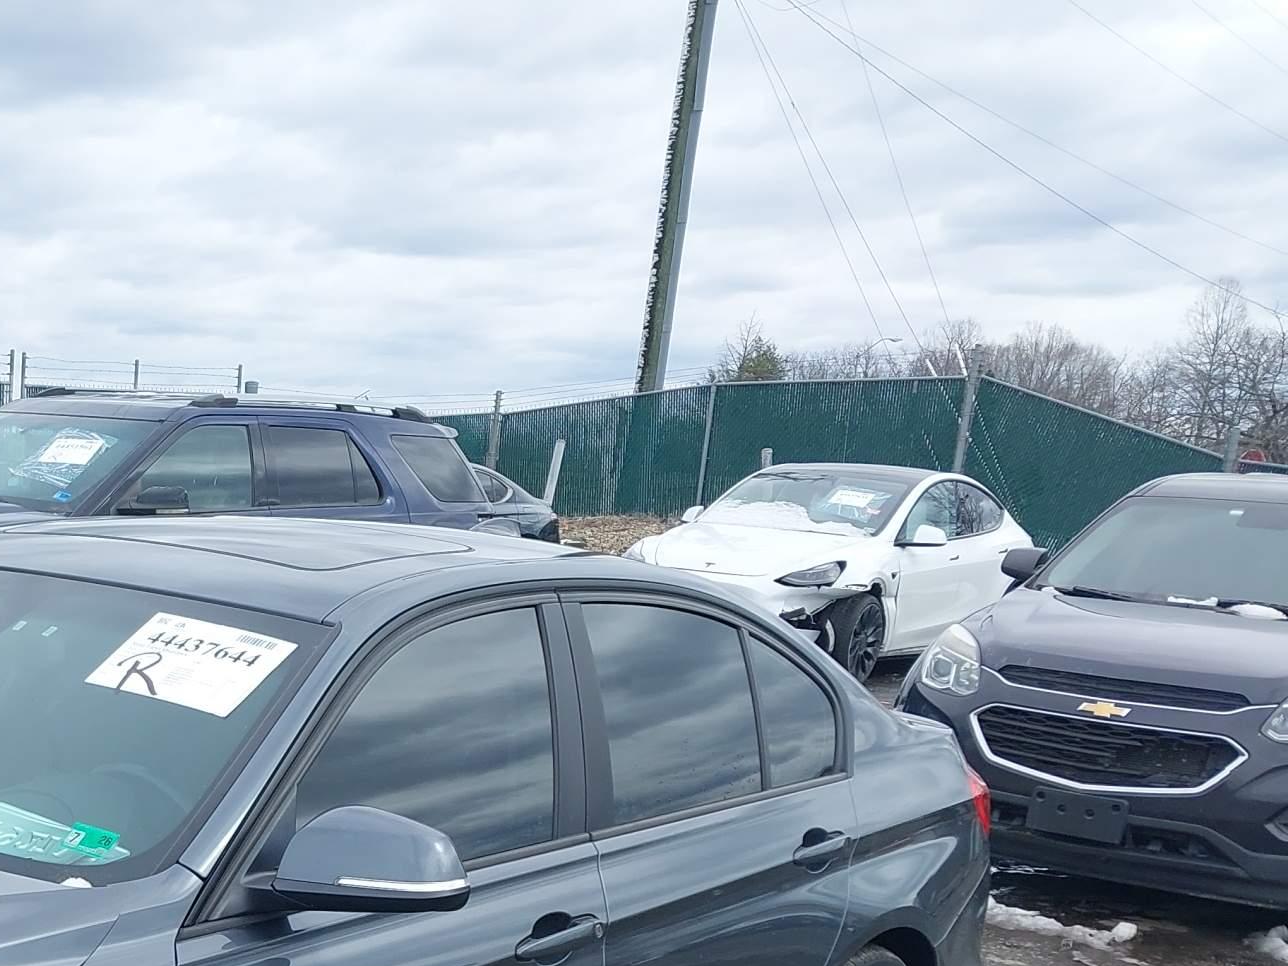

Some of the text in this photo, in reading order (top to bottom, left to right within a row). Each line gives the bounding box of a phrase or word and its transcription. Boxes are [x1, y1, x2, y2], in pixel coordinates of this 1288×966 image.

[147, 631, 262, 667] 44437644
[116, 651, 162, 696] R
[69, 832, 81, 843] 7
[98, 835, 114, 848] 26
